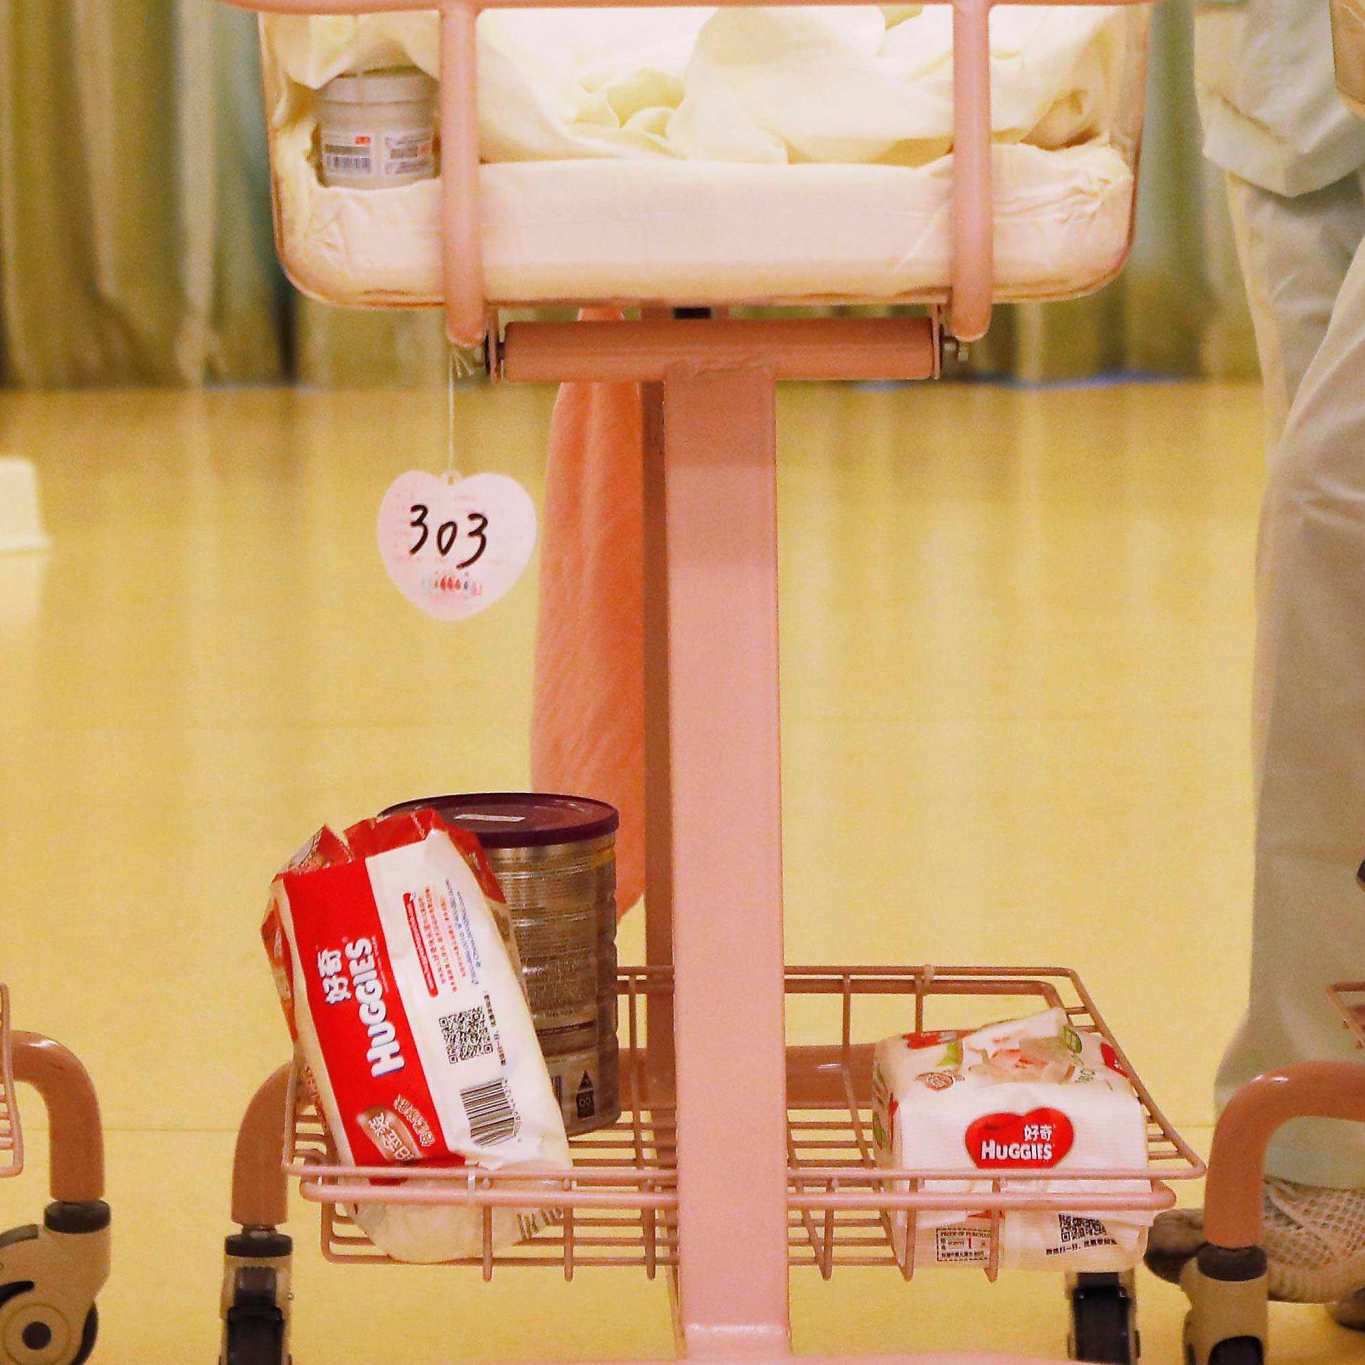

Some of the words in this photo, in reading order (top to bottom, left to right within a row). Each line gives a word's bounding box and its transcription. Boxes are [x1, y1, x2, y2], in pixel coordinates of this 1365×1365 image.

[409, 504, 489, 570] 303
[316, 946, 354, 1006] 好奇
[344, 936, 407, 1079] HUGGIES
[980, 1138, 1055, 1162] HUGGIES
[1022, 1124, 1054, 1143] 好奇
